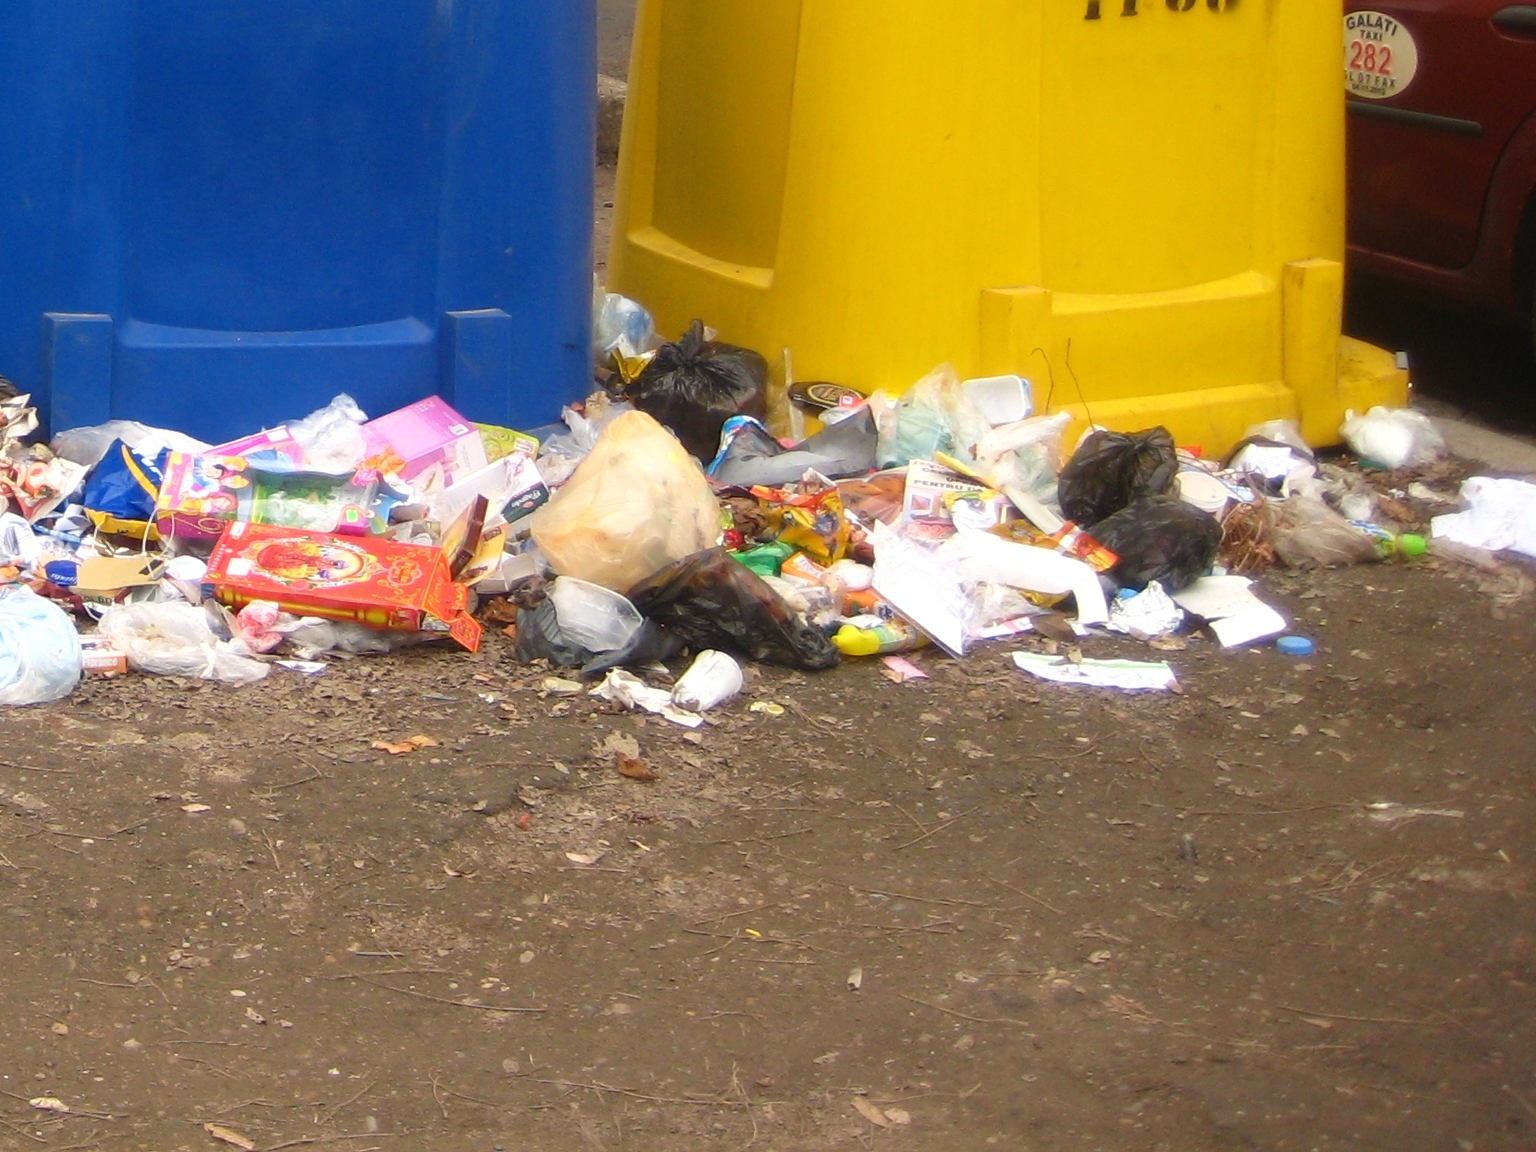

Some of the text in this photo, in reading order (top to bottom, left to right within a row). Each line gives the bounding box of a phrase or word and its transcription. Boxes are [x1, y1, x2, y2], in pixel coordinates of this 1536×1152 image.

[1346, 13, 1398, 36] GALATI
[1360, 30, 1383, 41] TAXI
[1350, 40, 1392, 75] 282
[1374, 75, 1396, 88] FAX
[914, 480, 963, 490] PENTRU
